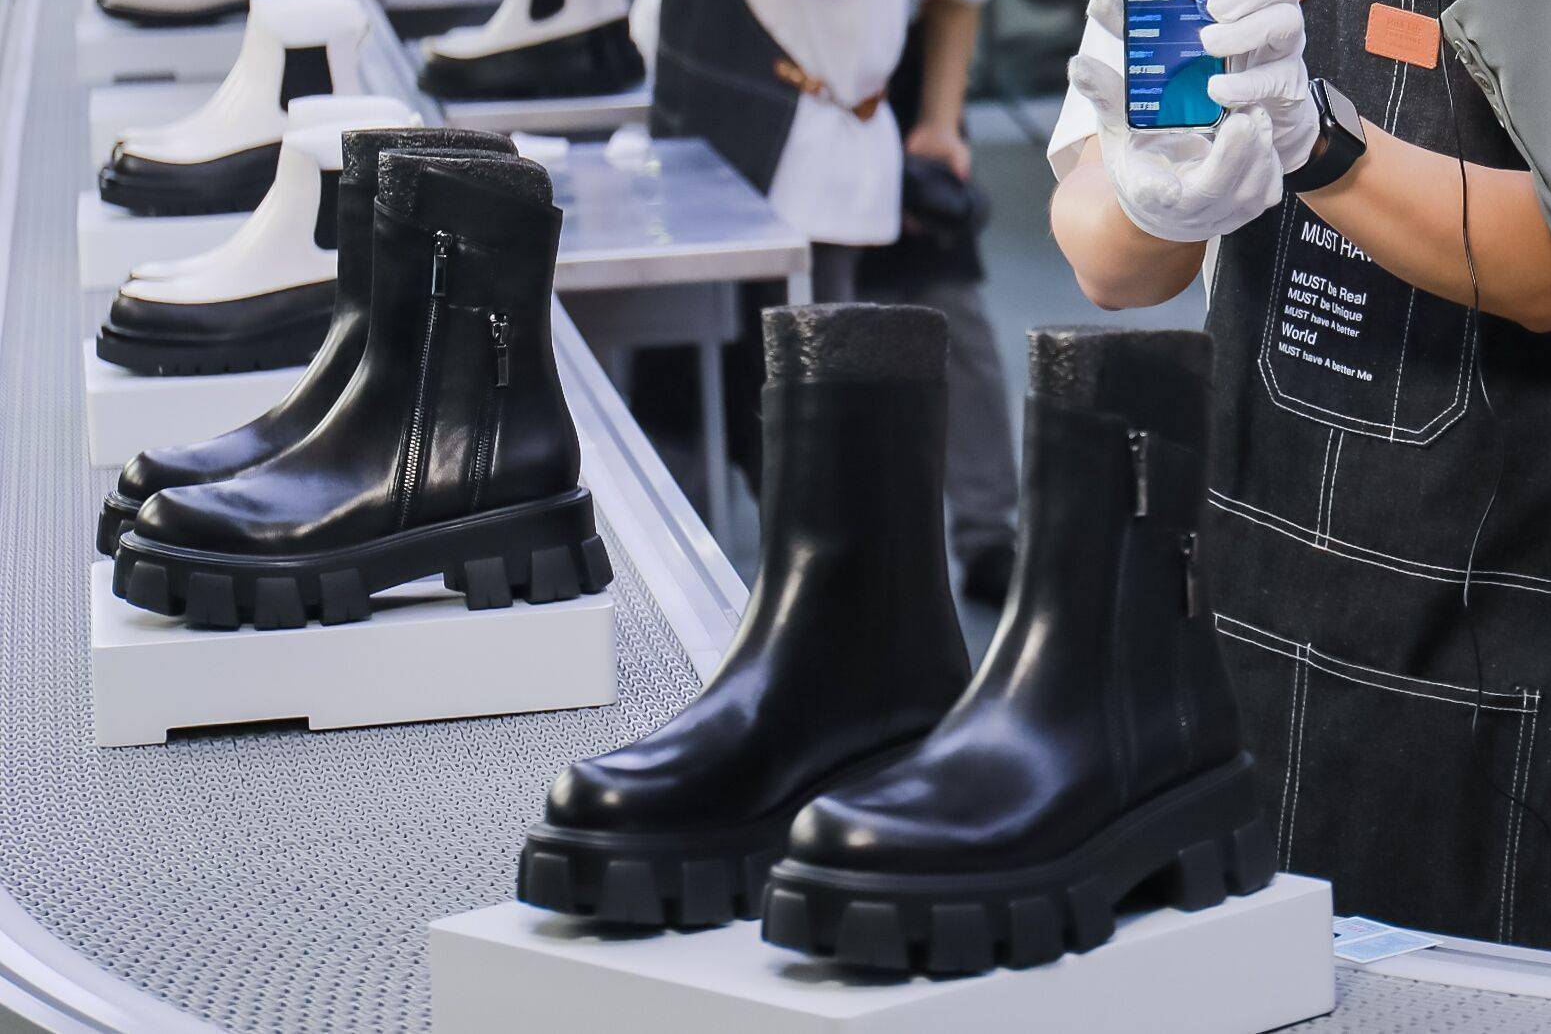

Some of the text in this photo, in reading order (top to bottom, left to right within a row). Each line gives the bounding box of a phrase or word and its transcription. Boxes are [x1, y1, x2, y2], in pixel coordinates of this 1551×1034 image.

[1301, 220, 1372, 262] MUST HA
[1287, 287, 1363, 321] MUST be Unique
[1291, 269, 1367, 305] MUST be Real
[1282, 320, 1318, 345] World
[1284, 304, 1310, 320] MUST
[1310, 312, 1330, 327] have
[1336, 322, 1360, 338] better
[1278, 341, 1373, 381] MUST have A better Me
